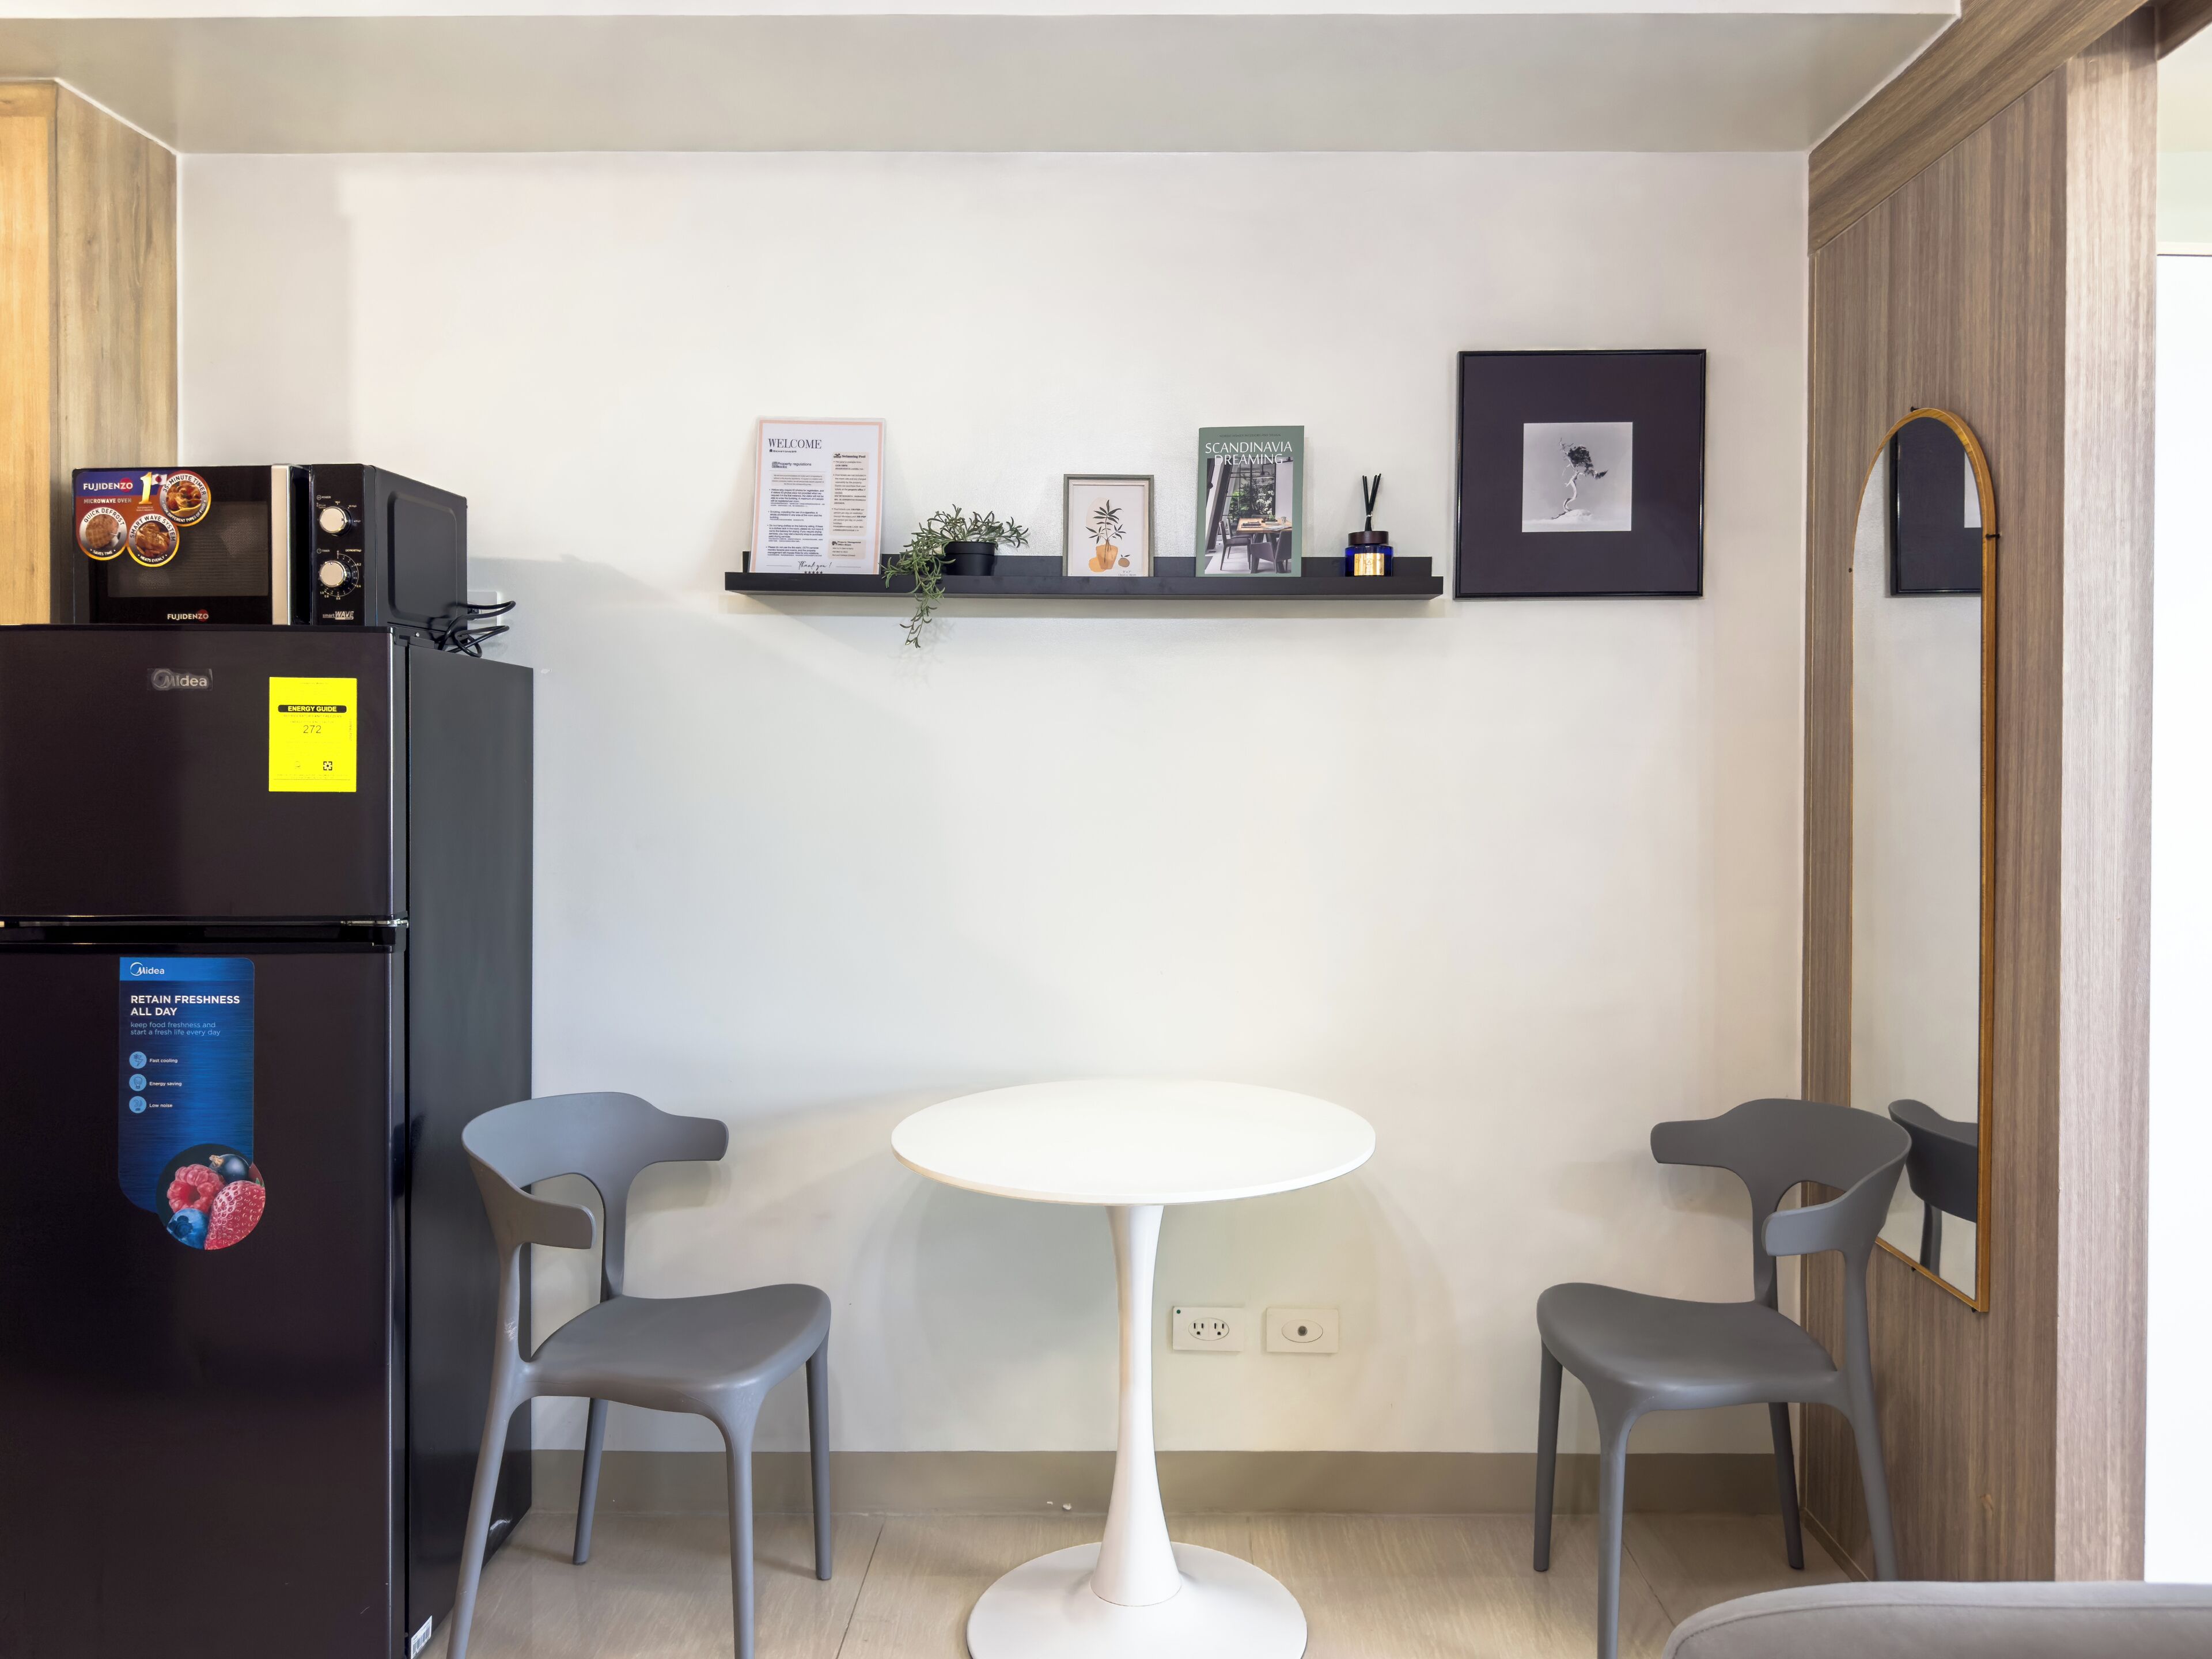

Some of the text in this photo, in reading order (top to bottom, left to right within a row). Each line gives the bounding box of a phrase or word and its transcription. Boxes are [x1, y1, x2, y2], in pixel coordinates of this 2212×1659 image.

[768, 438, 821, 449] WELCOME
[1205, 441, 1292, 453] SCANDINAVIA
[1214, 454, 1283, 465] DREAMING
[83, 482, 133, 491] FUJIDENZO
[163, 475, 206, 495] 35-MINUTE TIMER
[84, 508, 125, 525] QUICK DEFROST
[167, 512, 185, 522] DIFFERENT
[130, 519, 143, 538] SMART
[162, 518, 176, 541] SYSTEM
[798, 561, 815, 570] Thank
[154, 671, 207, 688] Midea
[303, 725, 321, 733] 272
[130, 963, 165, 976] Midea
[131, 995, 240, 1004] RETAIN FRESHNESS
[155, 1007, 177, 1016] DAY
